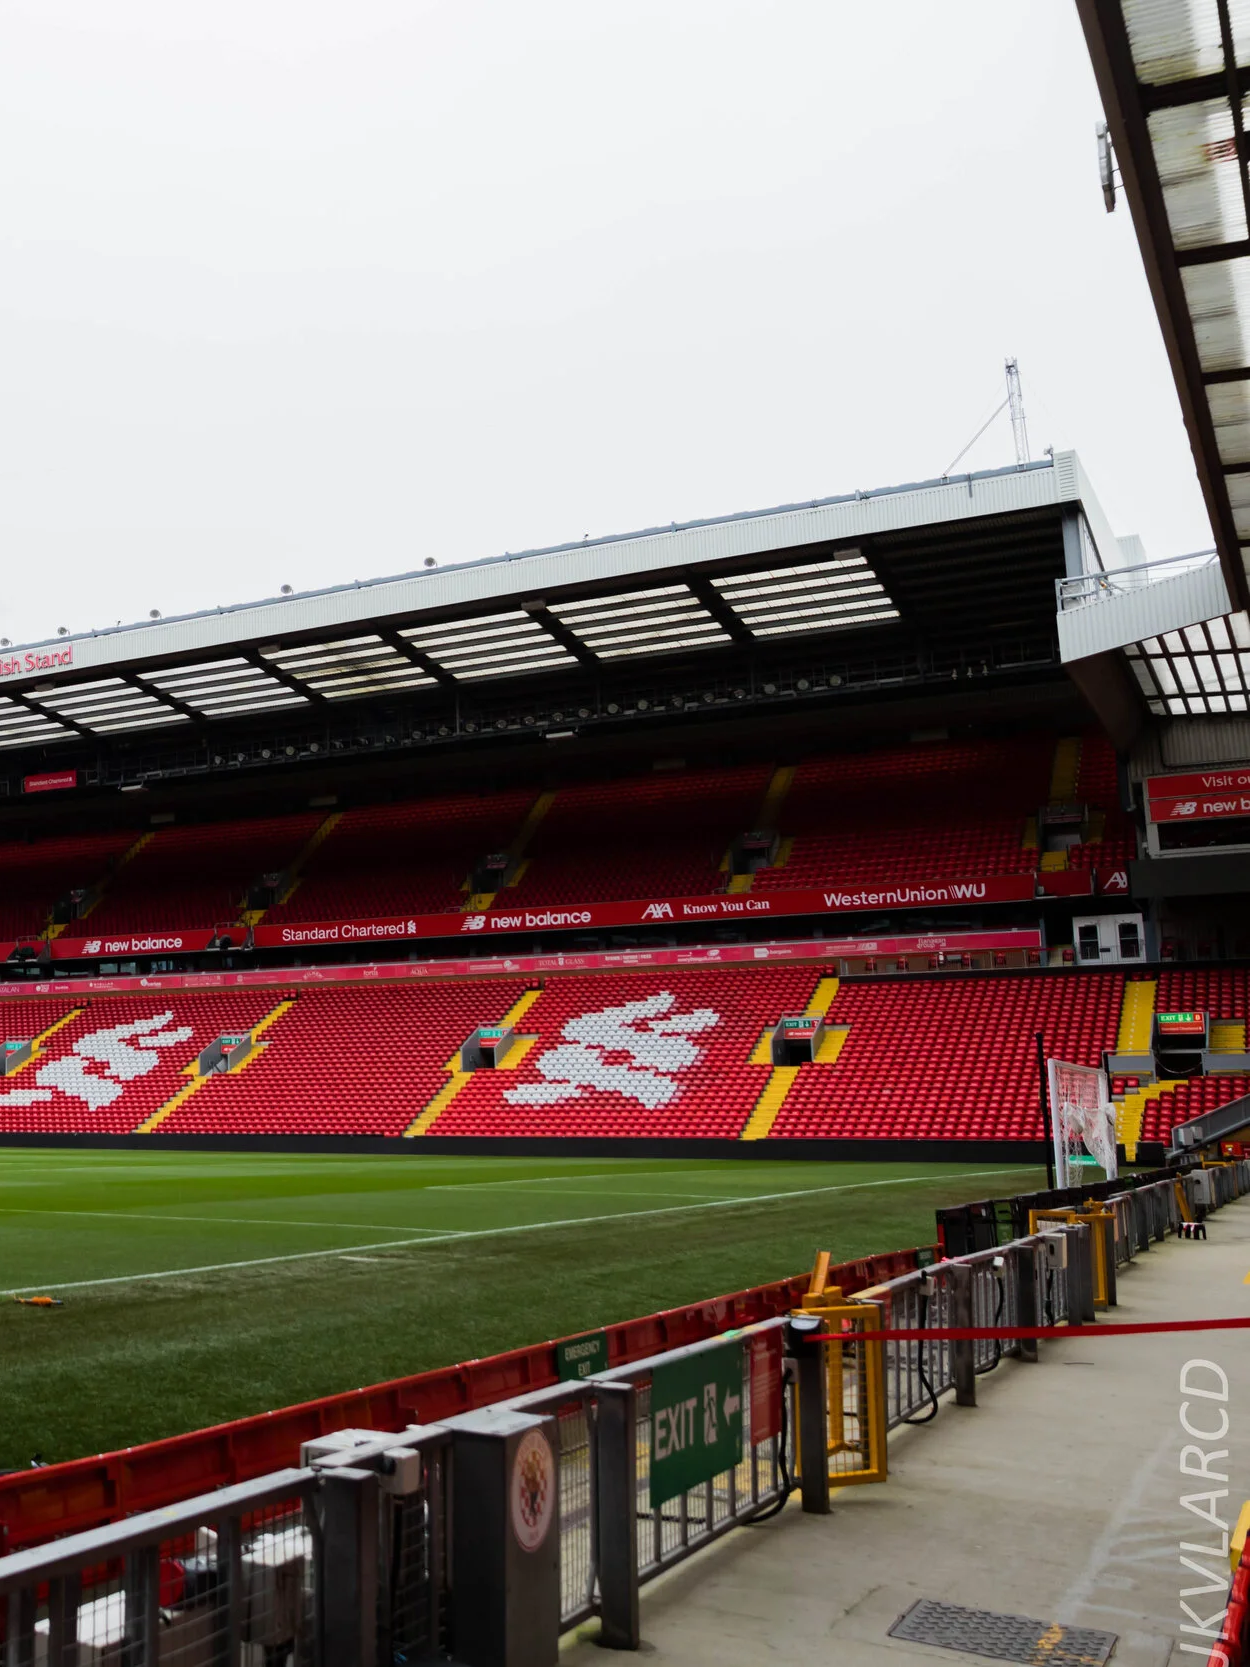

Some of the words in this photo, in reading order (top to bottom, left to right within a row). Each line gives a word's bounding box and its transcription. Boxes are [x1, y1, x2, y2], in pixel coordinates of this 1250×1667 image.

[24, 646, 73, 671] Stand
[1202, 775, 1234, 788] Visit
[1203, 800, 1236, 813] new
[823, 886, 948, 907] WesternUnion
[641, 902, 674, 920] AXA
[683, 904, 718, 915] Know
[720, 901, 744, 912] You
[746, 899, 770, 910] Can
[491, 916, 523, 929] new
[525, 911, 591, 927] balance
[282, 926, 338, 942] Standard
[341, 922, 405, 939] Chartered
[105, 942, 129, 953] new
[131, 937, 182, 951] balance
[565, 1340, 600, 1361] EMERGENCY
[578, 1361, 590, 1377] EXIT
[655, 1396, 697, 1461] EXIT
